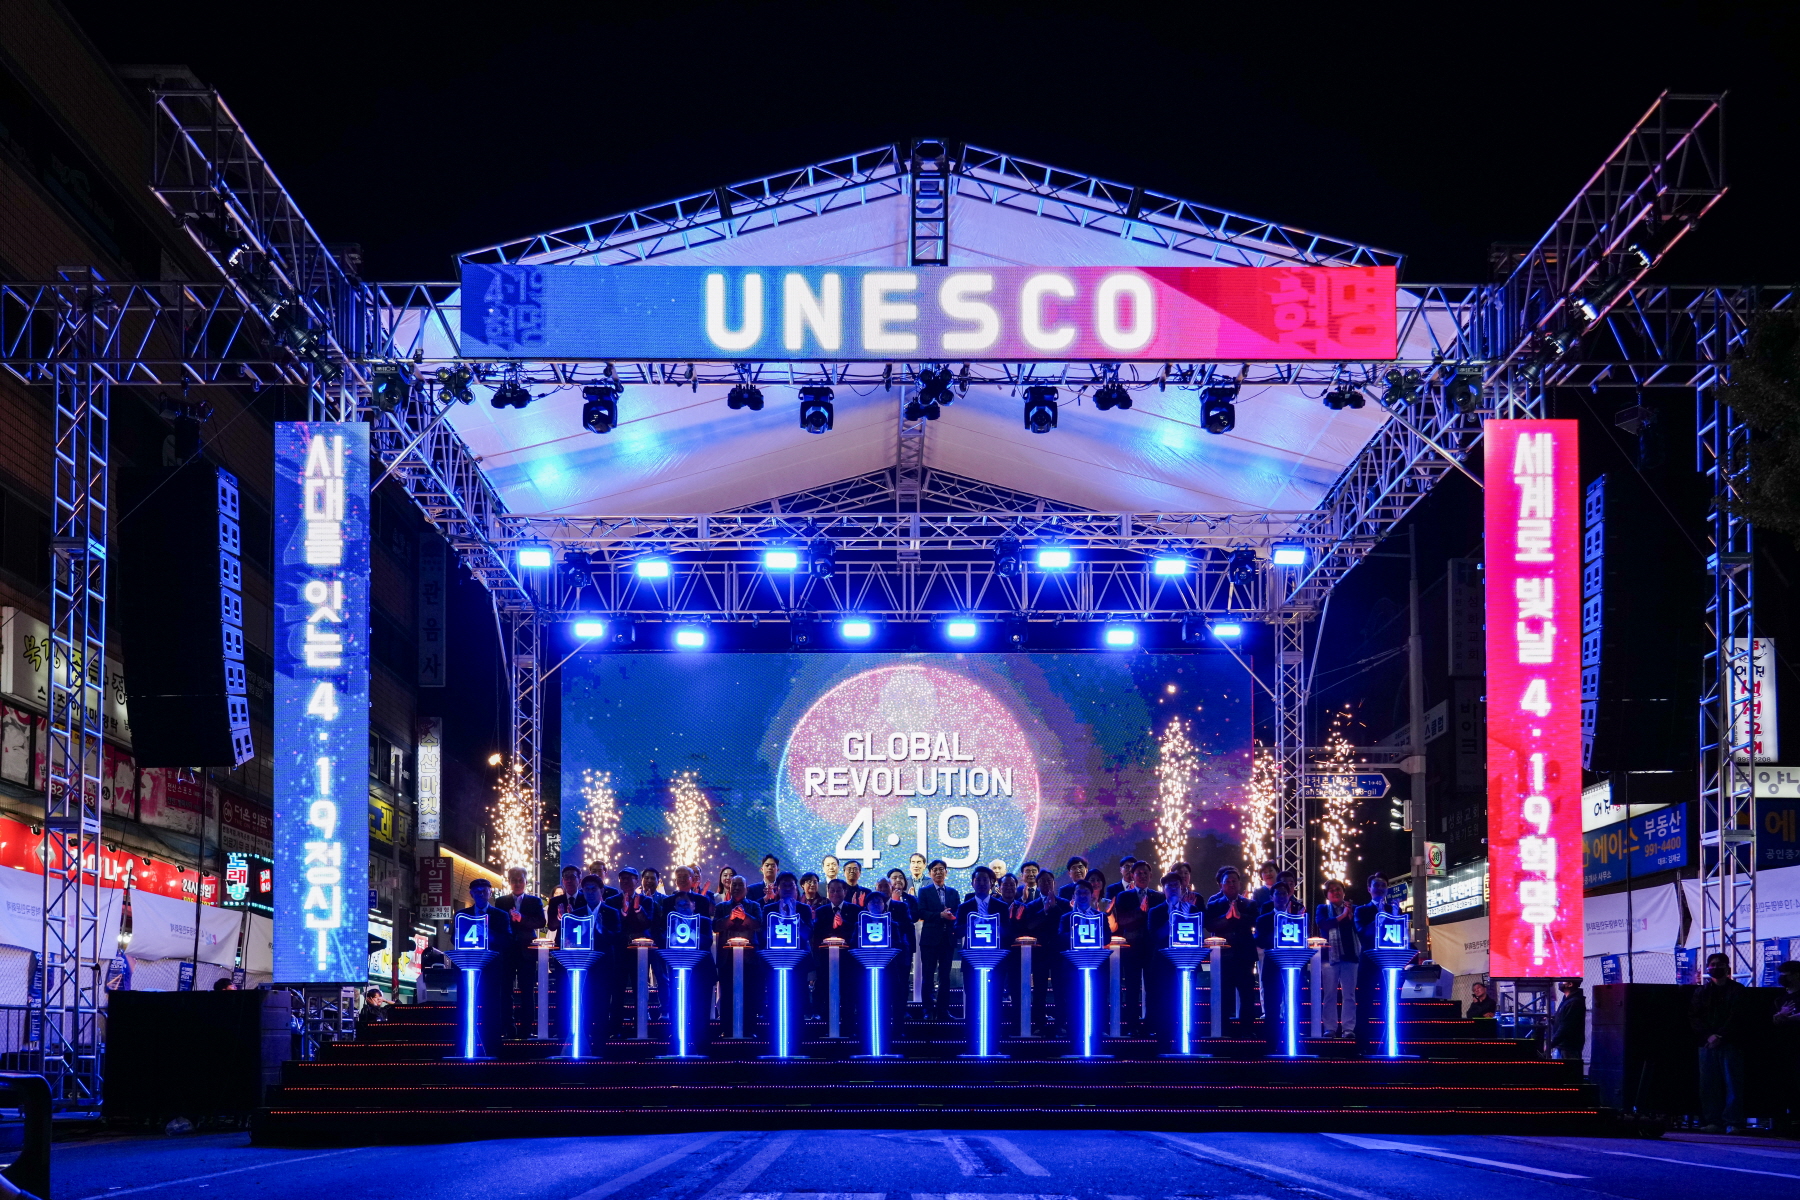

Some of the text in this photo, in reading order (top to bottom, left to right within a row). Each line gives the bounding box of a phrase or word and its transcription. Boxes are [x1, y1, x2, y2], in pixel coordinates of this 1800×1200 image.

[706, 273, 1153, 350] UNESCO
[422, 580, 441, 679] 관음사
[38, 686, 66, 709] 스츠
[71, 701, 97, 723] 아마
[303, 435, 343, 971] 시대를 잇는 4·19정신!
[1514, 433, 1556, 965] 세계로 빛낼 4·19혁명!
[844, 731, 975, 761] GLOBAL
[1461, 702, 1477, 755] 바이크
[419, 732, 438, 816] 수산마켓
[805, 766, 1014, 796] REVOLUTION
[1305, 777, 1329, 788] 천로
[234, 805, 251, 822] 더온
[369, 804, 409, 848] 래방
[836, 806, 981, 869] 4·19
[1431, 850, 1440, 862] 30
[1592, 811, 1682, 864] 에이스 부동산
[1644, 836, 1682, 857] 991-4400
[227, 855, 249, 900] 노래방
[424, 858, 447, 868] 더온
[428, 869, 443, 907] 의료기
[464, 922, 1402, 945] 4 1 9 혁 명 국 민 문 화 제
